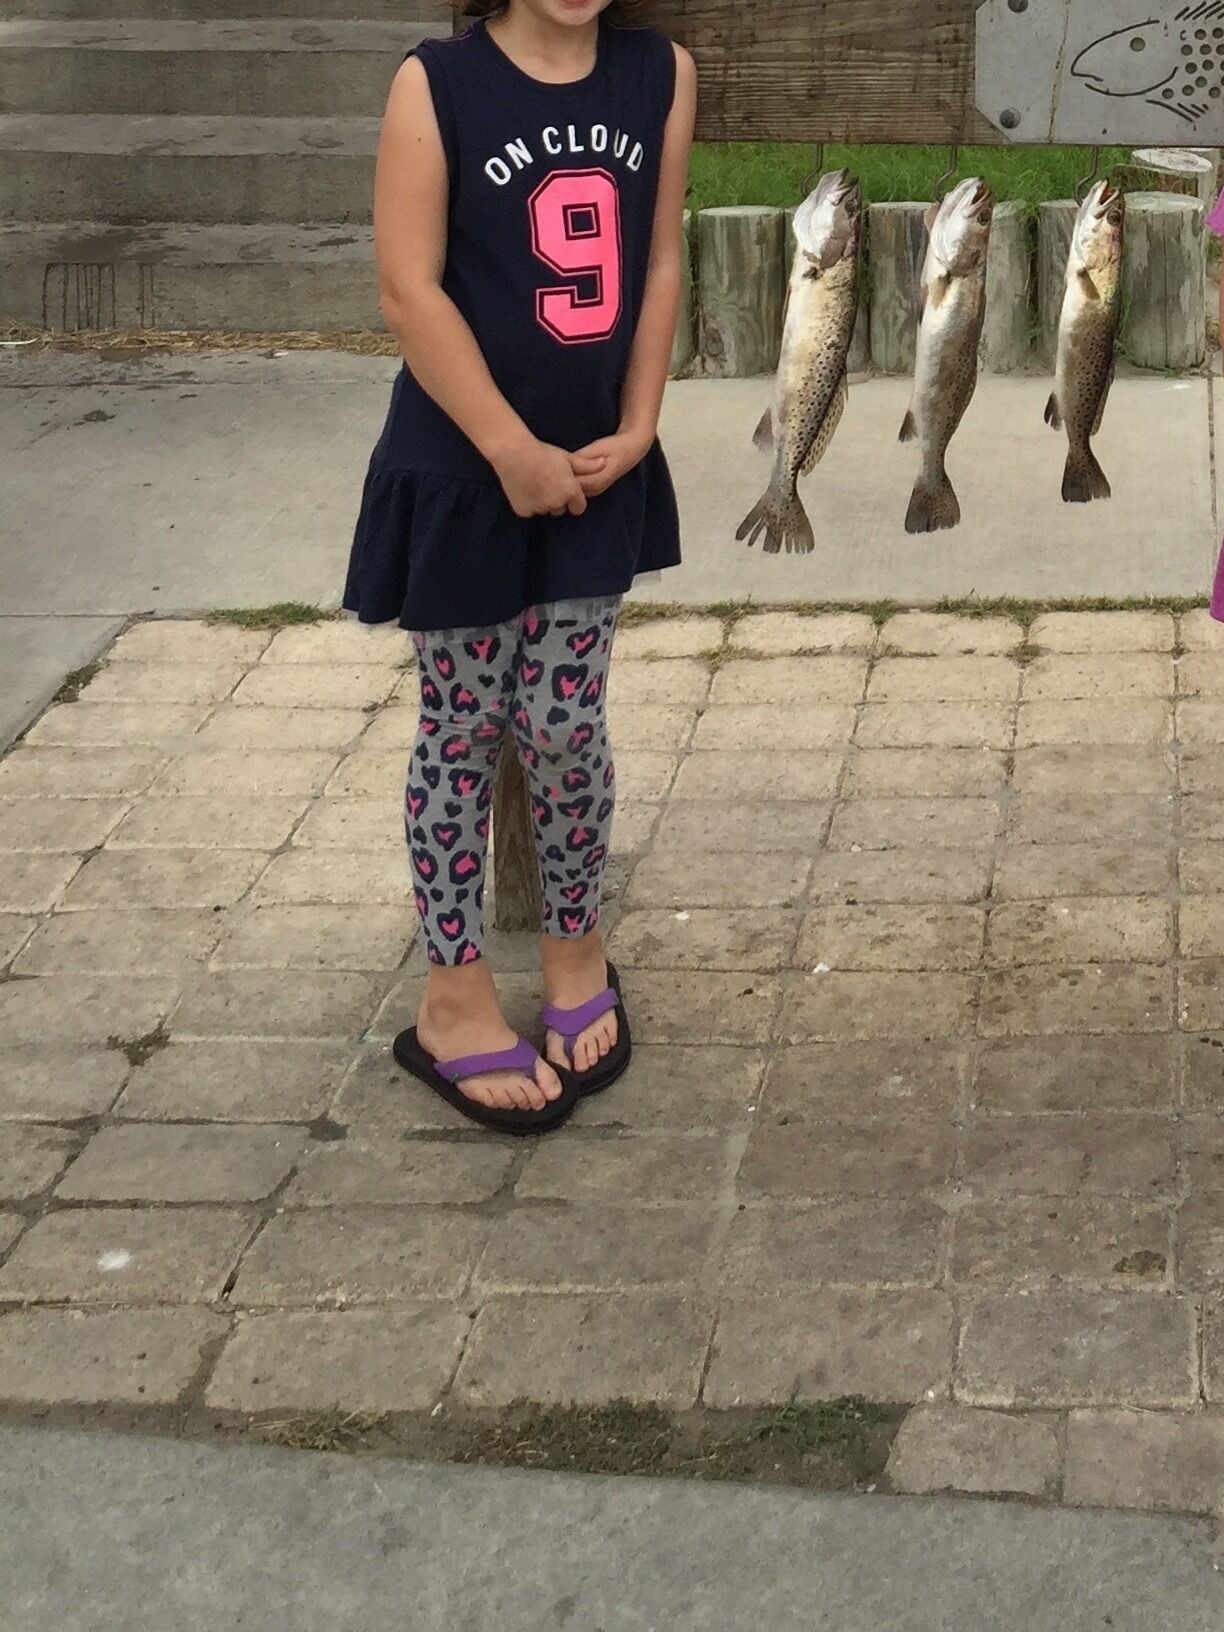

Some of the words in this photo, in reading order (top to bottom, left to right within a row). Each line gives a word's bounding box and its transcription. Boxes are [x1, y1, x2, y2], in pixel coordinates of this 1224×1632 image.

[484, 136, 535, 186] ON
[541, 124, 645, 173] CLOUD
[527, 166, 624, 345] 9
